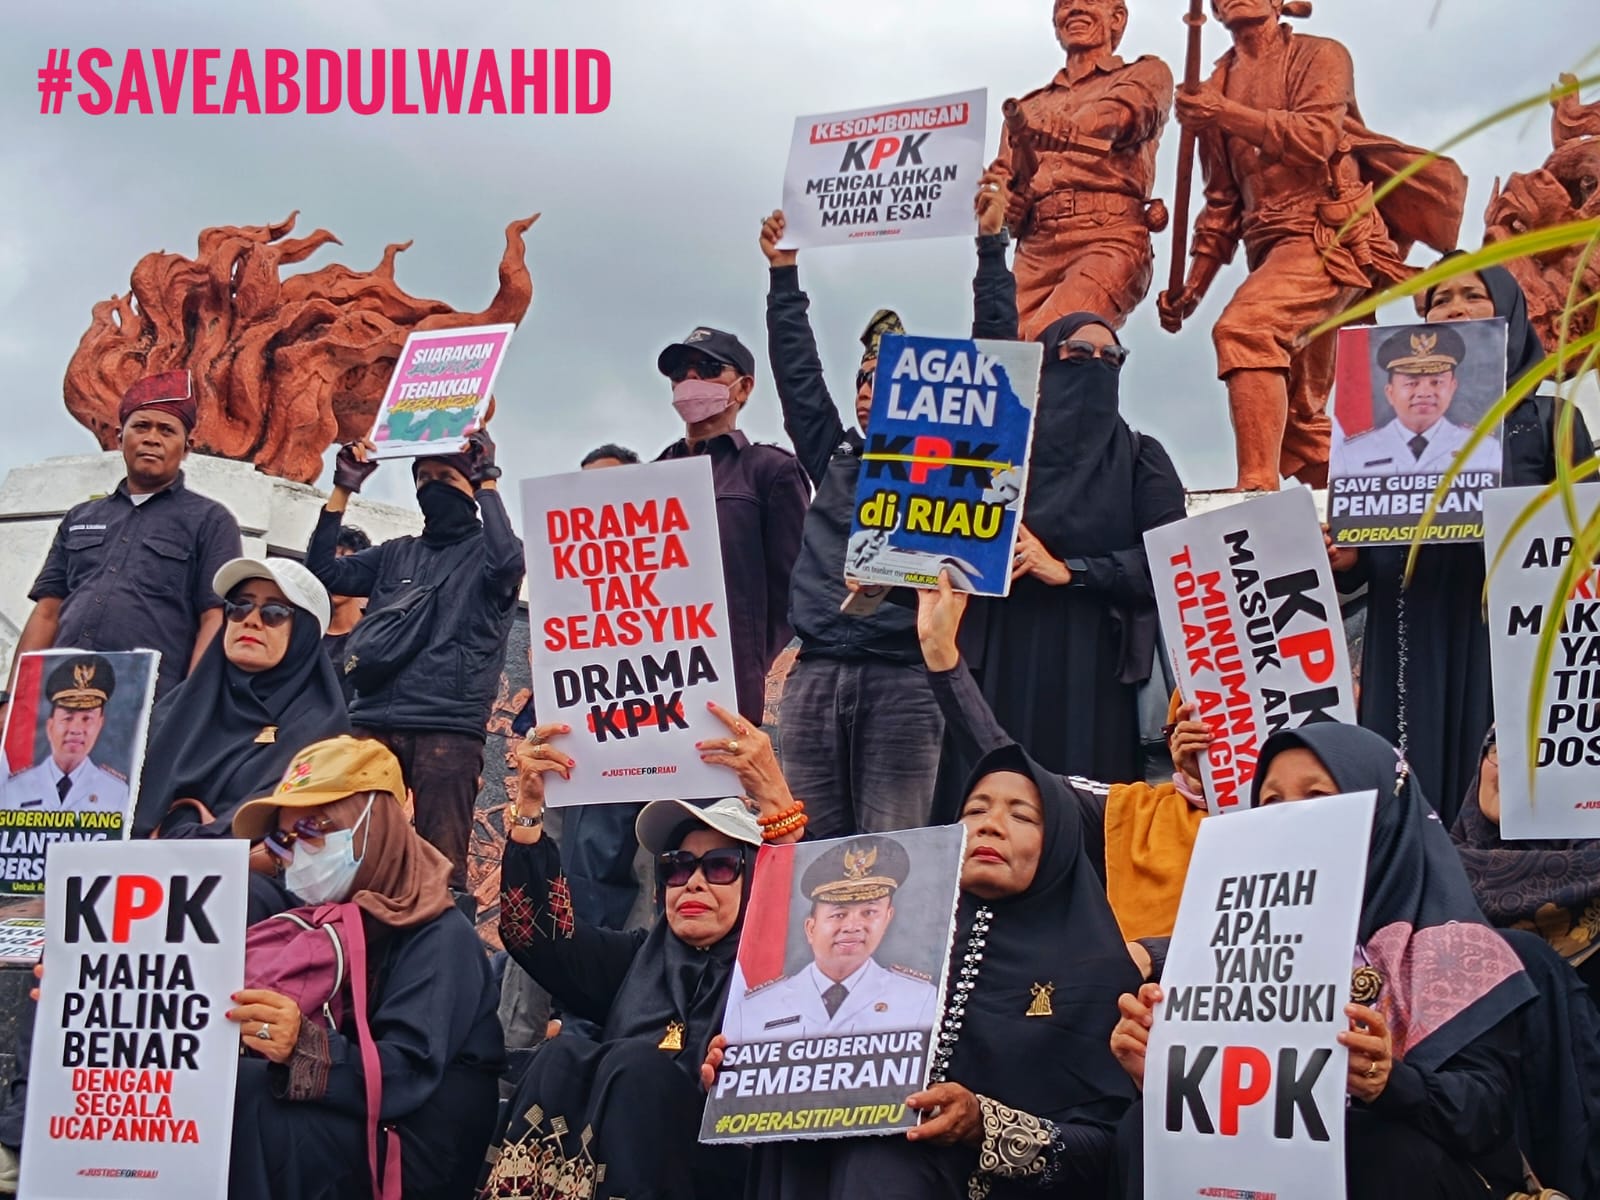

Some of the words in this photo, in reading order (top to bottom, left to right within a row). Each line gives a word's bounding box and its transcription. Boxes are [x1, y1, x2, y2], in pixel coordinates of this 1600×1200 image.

[815, 104, 964, 140] KESOMBONGAN
[840, 132, 930, 173] KPK
[806, 165, 957, 195] MENGALAHKAN
[818, 190, 883, 210] TUHAN
[892, 184, 941, 204] YANG
[821, 208, 878, 227] MAHA
[886, 203, 932, 221] ESA!
[412, 343, 494, 364] SUARAKAN
[892, 348, 1000, 386] AGAK
[399, 377, 481, 399] TEGAKKAN
[887, 382, 996, 426] LAEN
[866, 435, 999, 489] KPK
[1334, 477, 1381, 493] SAVE
[1386, 473, 1493, 491] GUBENUR
[547, 498, 689, 545] DRAMA
[860, 493, 897, 527] di
[907, 498, 1001, 537] RIAU
[553, 534, 689, 580] KOREA
[583, 573, 660, 612] TAK
[1170, 545, 1214, 677] TOLAK
[1224, 529, 1281, 674] MASUK
[544, 603, 717, 651] SEASYIK
[553, 645, 719, 708] DRAMA
[1197, 571, 1260, 785] MINUMNYA
[590, 691, 690, 743] KPK
[602, 766, 677, 777] #JUSTICEFORRIAU
[0, 811, 75, 828] GUBERNUR
[79, 813, 121, 828] YANG
[65, 875, 220, 943] KPK
[1215, 870, 1317, 911] ENTAH
[1210, 910, 1302, 947] APA...
[79, 954, 194, 990] MAHA
[1215, 946, 1294, 983] YANG
[62, 993, 209, 1030] PALING
[1164, 984, 1336, 1022] MERASUKI
[62, 1032, 199, 1070] BENAR
[722, 1043, 782, 1066] SAVE
[788, 1031, 922, 1060] GUBERNUR
[72, 1069, 173, 1094] DENGAN
[715, 1056, 921, 1099] PEMBERANI
[1165, 1045, 1332, 1142] KPK
[75, 1093, 173, 1118] SEGALA
[715, 1104, 906, 1133] #OPERASITIPUTIPU
[50, 1116, 199, 1144] UCAPANNYA
[77, 1169, 159, 1178] #JUSTICEFORRIAU
